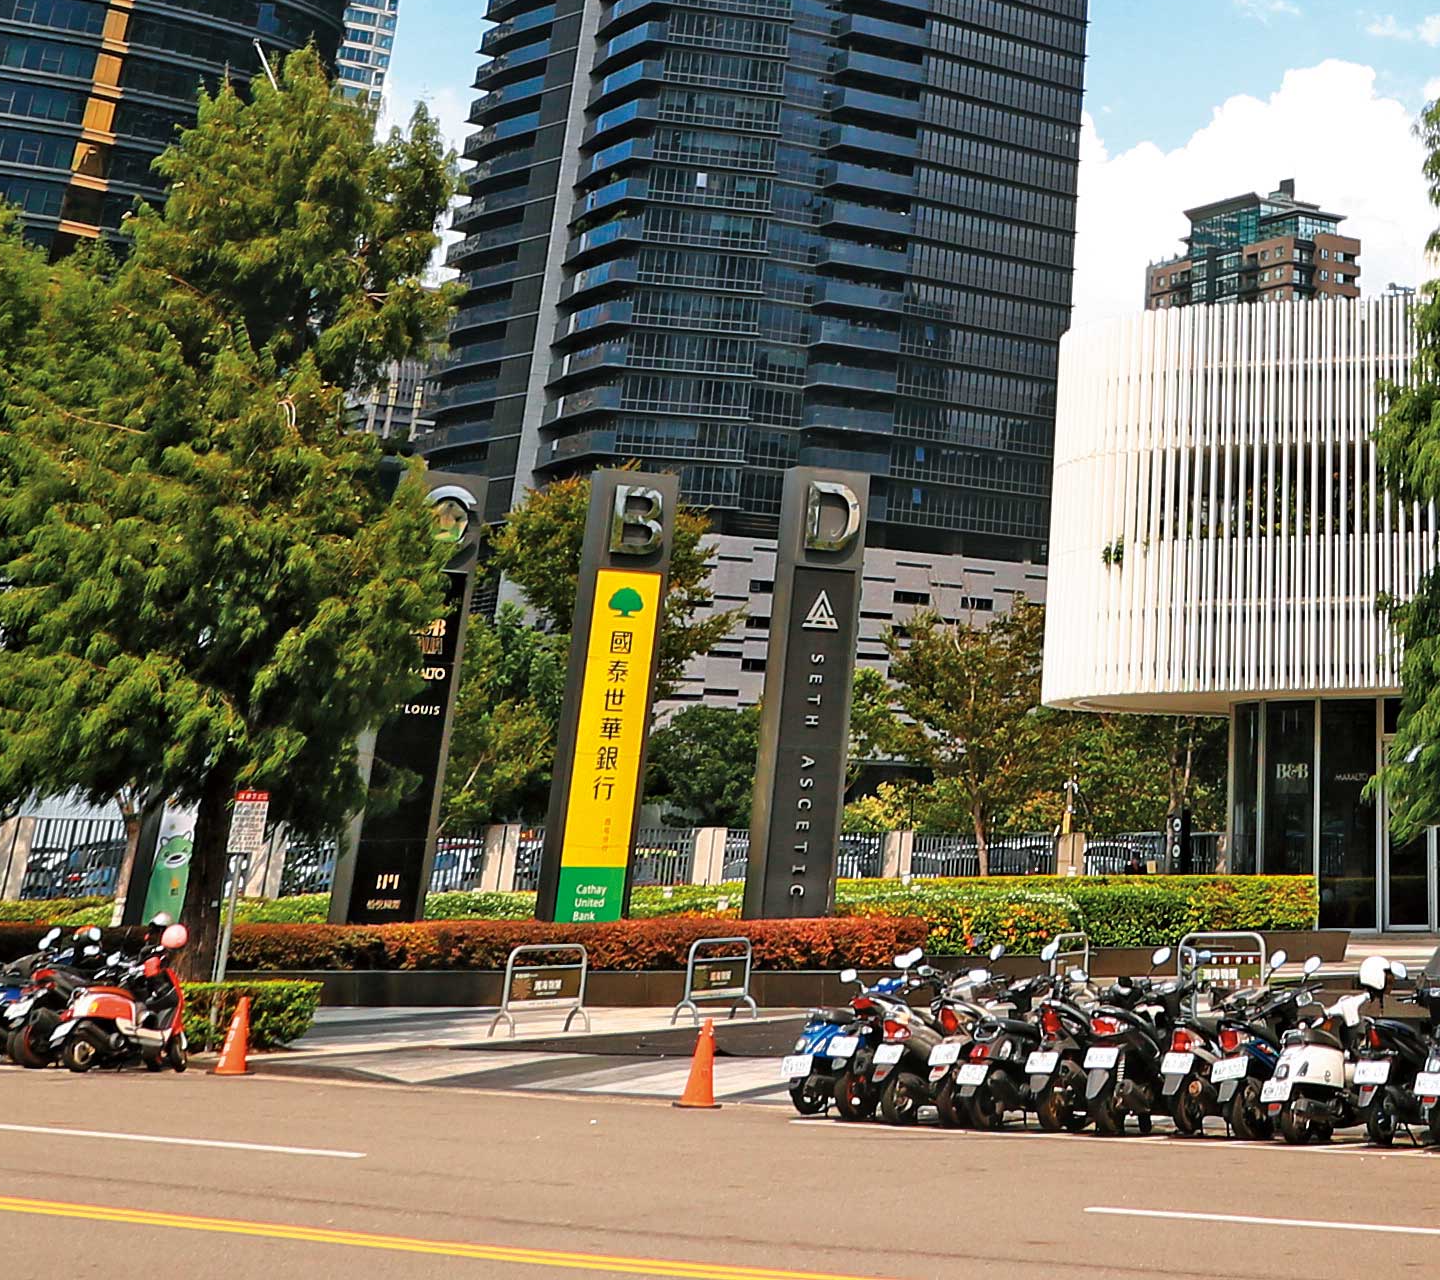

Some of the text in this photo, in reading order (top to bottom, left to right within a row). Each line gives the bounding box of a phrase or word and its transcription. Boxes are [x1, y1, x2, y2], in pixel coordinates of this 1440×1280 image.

[609, 485, 665, 555] B
[804, 480, 861, 552] D
[592, 631, 633, 801] 國泰世華銀行
[789, 653, 826, 898] SETH ASCETIC
[1275, 762, 1309, 779] B&B
[574, 897, 605, 908] United
[575, 884, 608, 897] Cathay
[572, 911, 596, 922] Bank
